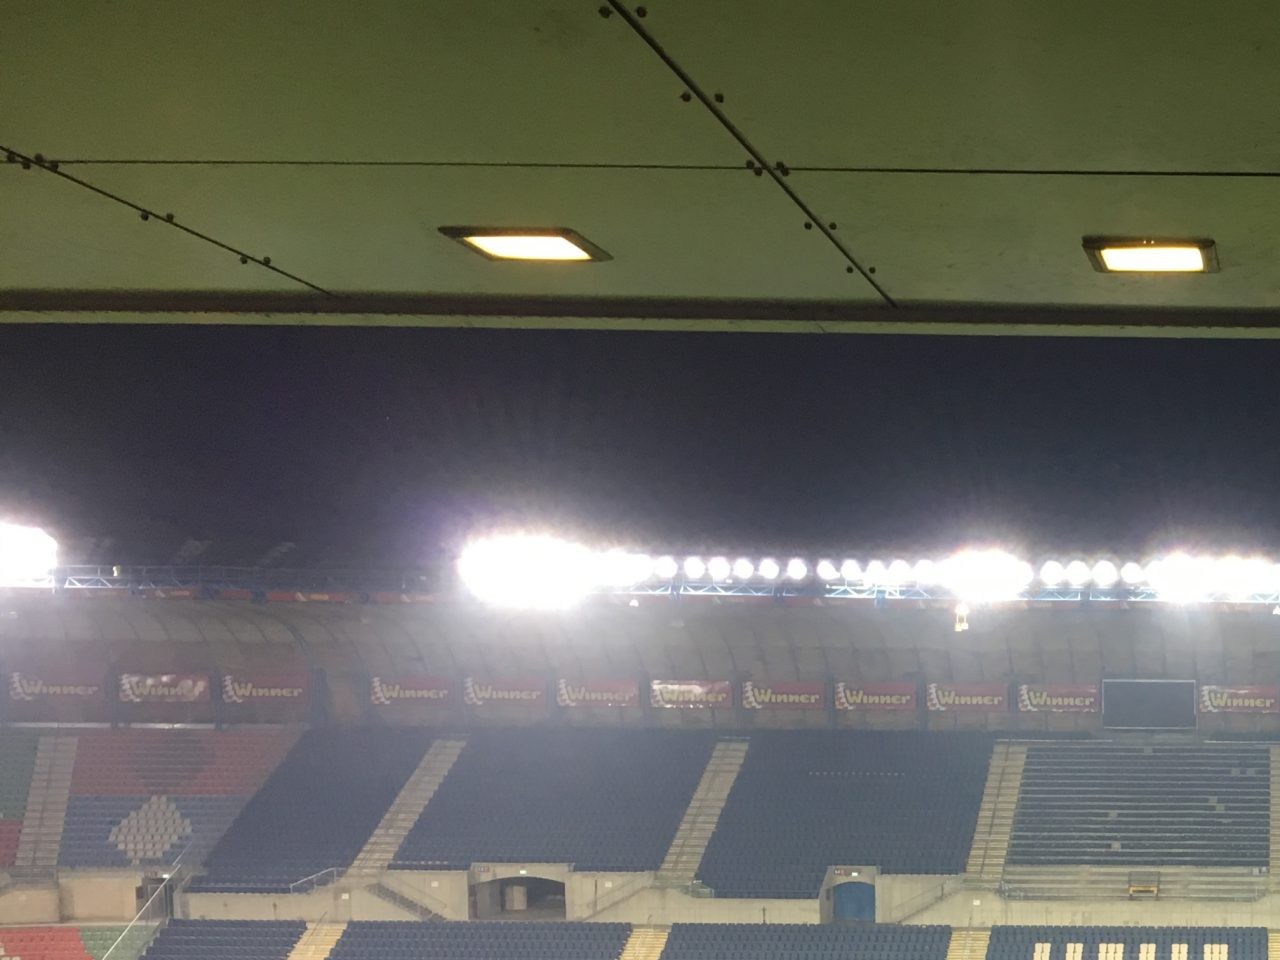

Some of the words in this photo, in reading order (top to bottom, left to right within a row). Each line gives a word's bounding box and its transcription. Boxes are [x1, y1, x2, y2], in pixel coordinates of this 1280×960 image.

[753, 686, 820, 705] Winner
[845, 687, 911, 705] Winner
[937, 688, 1004, 706] Winner
[1029, 690, 1095, 707] Winner
[1209, 691, 1275, 708] Winner
